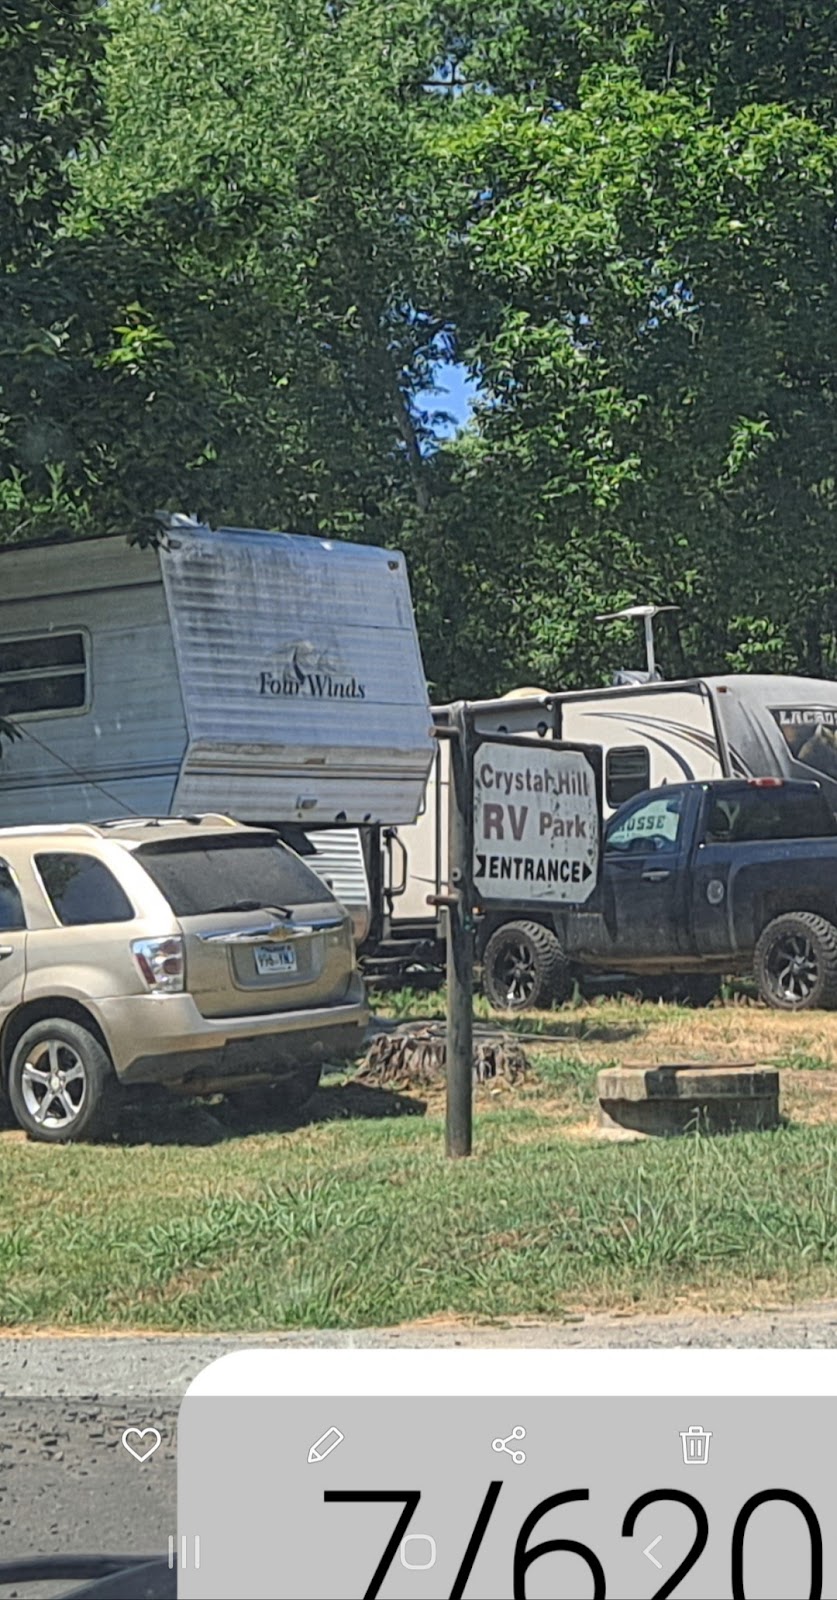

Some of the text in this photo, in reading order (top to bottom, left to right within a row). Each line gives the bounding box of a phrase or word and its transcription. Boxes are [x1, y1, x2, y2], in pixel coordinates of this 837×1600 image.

[259, 671, 366, 698] Four Winds
[480, 763, 588, 796] Crystal Hill
[483, 803, 587, 841] RV Park
[489, 856, 580, 883] ENTRANCE
